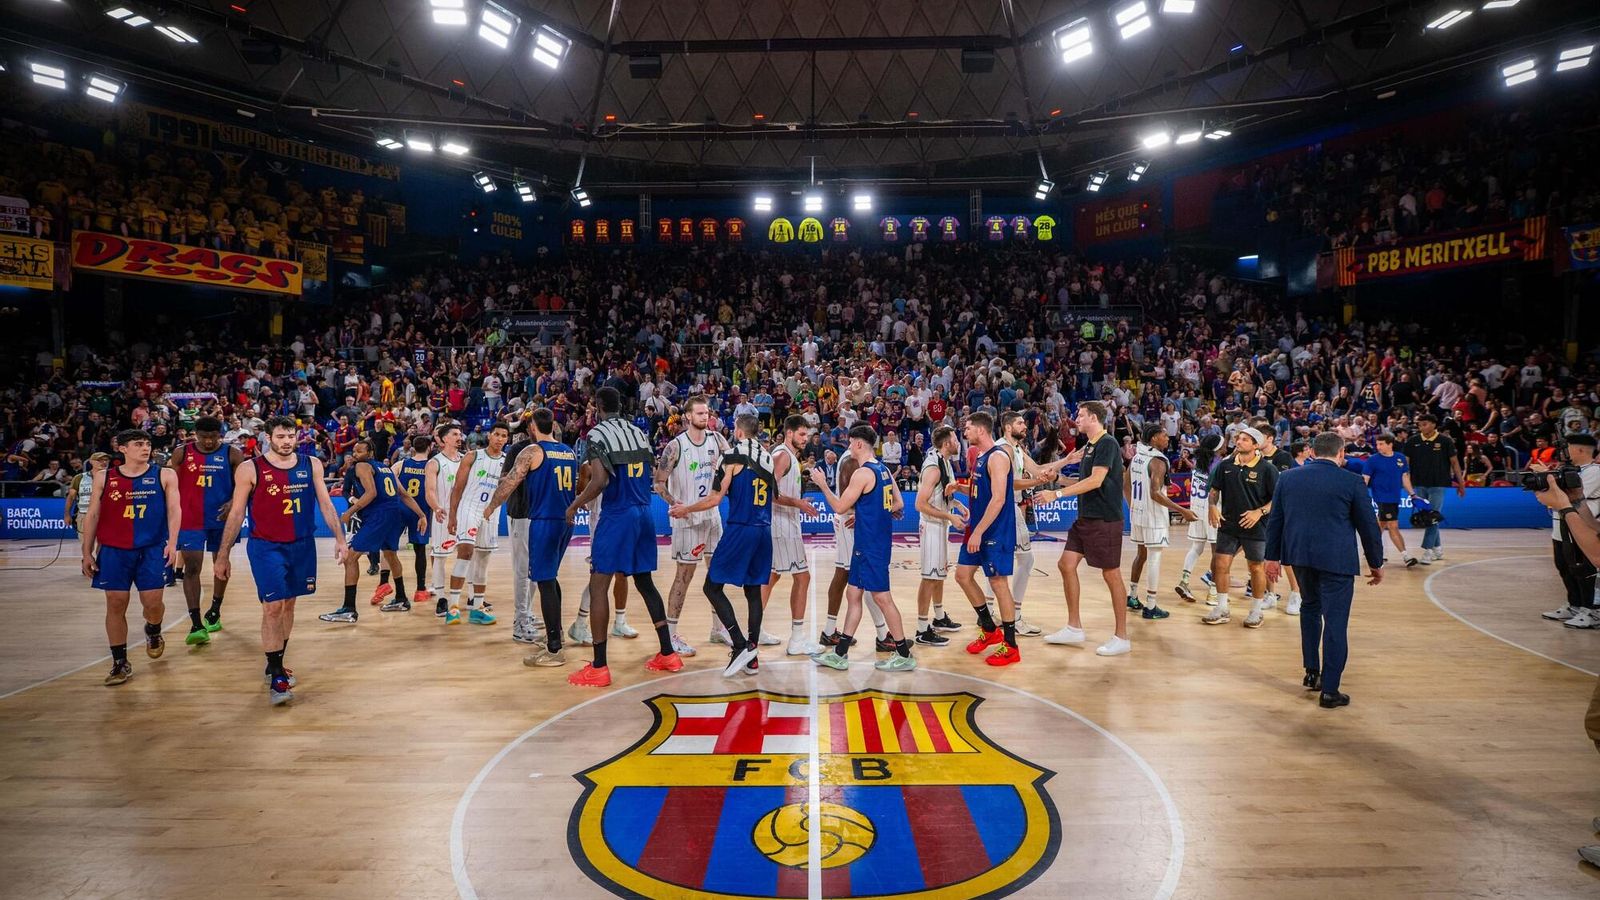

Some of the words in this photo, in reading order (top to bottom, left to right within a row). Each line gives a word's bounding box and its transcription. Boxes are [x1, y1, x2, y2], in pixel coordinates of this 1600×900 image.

[147, 111, 212, 149] 1991
[1117, 204, 1139, 219] QUE
[492, 212, 521, 228] 100%
[1039, 222, 1050, 230] 28
[1113, 218, 1139, 233] CLUB
[490, 223, 522, 241] CULER
[597, 226, 607, 234] 12
[622, 226, 632, 234] 11
[662, 224, 668, 233] 7
[682, 224, 689, 233] 4
[703, 224, 715, 233] 21
[731, 224, 738, 233] 9
[778, 224, 784, 232] 1
[805, 224, 816, 232] 16
[887, 223, 893, 232] 8
[916, 223, 923, 232] 7
[946, 223, 952, 231] 5
[993, 223, 999, 231] 4
[1017, 223, 1024, 231] 2
[1368, 249, 1400, 272] PBB
[1405, 231, 1510, 268] MERITXELL
[123, 263, 256, 284] 1991
[415, 353, 425, 361] 20
[196, 475, 213, 488] 41
[554, 466, 572, 491] 14
[384, 477, 396, 497] 0
[407, 478, 420, 497] 8
[698, 485, 707, 498] 2
[752, 477, 768, 506] 13
[1132, 480, 1143, 500] 11
[480, 491, 489, 503] 0
[123, 504, 147, 519] 47
[282, 497, 302, 515] 21
[7, 508, 41, 521] BARÇA
